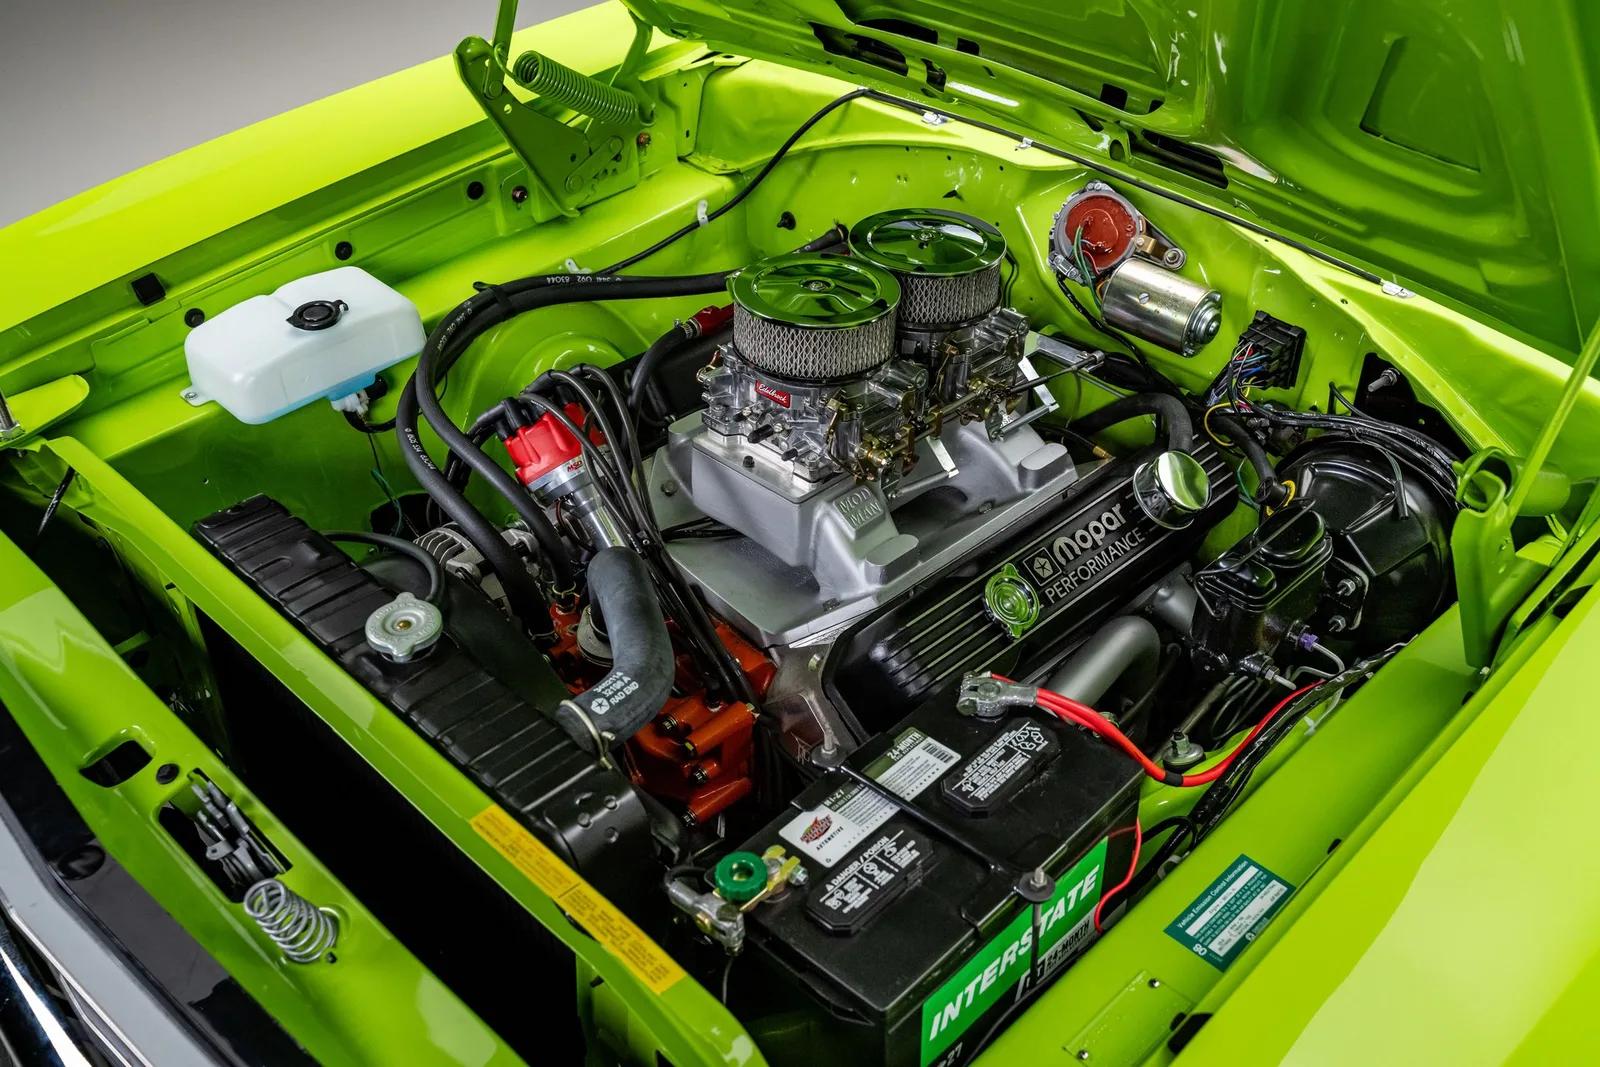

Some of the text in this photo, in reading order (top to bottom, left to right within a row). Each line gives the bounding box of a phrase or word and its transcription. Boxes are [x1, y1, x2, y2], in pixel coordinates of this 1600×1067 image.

[758, 383, 788, 404] Edelbrock
[566, 460, 583, 473] MSD
[839, 487, 872, 514] MOD
[850, 501, 882, 527] MAN
[1053, 503, 1127, 566] Mopar
[1044, 527, 1146, 604] PERFORMANCE
[609, 681, 638, 705] RAD END
[887, 731, 921, 759] 24-MONTH
[831, 860, 861, 886] DANGER
[863, 836, 890, 859] POISON
[1177, 912, 1195, 929] Vehicle
[1192, 895, 1213, 914] Emission
[1210, 881, 1227, 897] Control
[1224, 860, 1249, 883] Information
[929, 864, 1100, 1041] INTERSTATE
